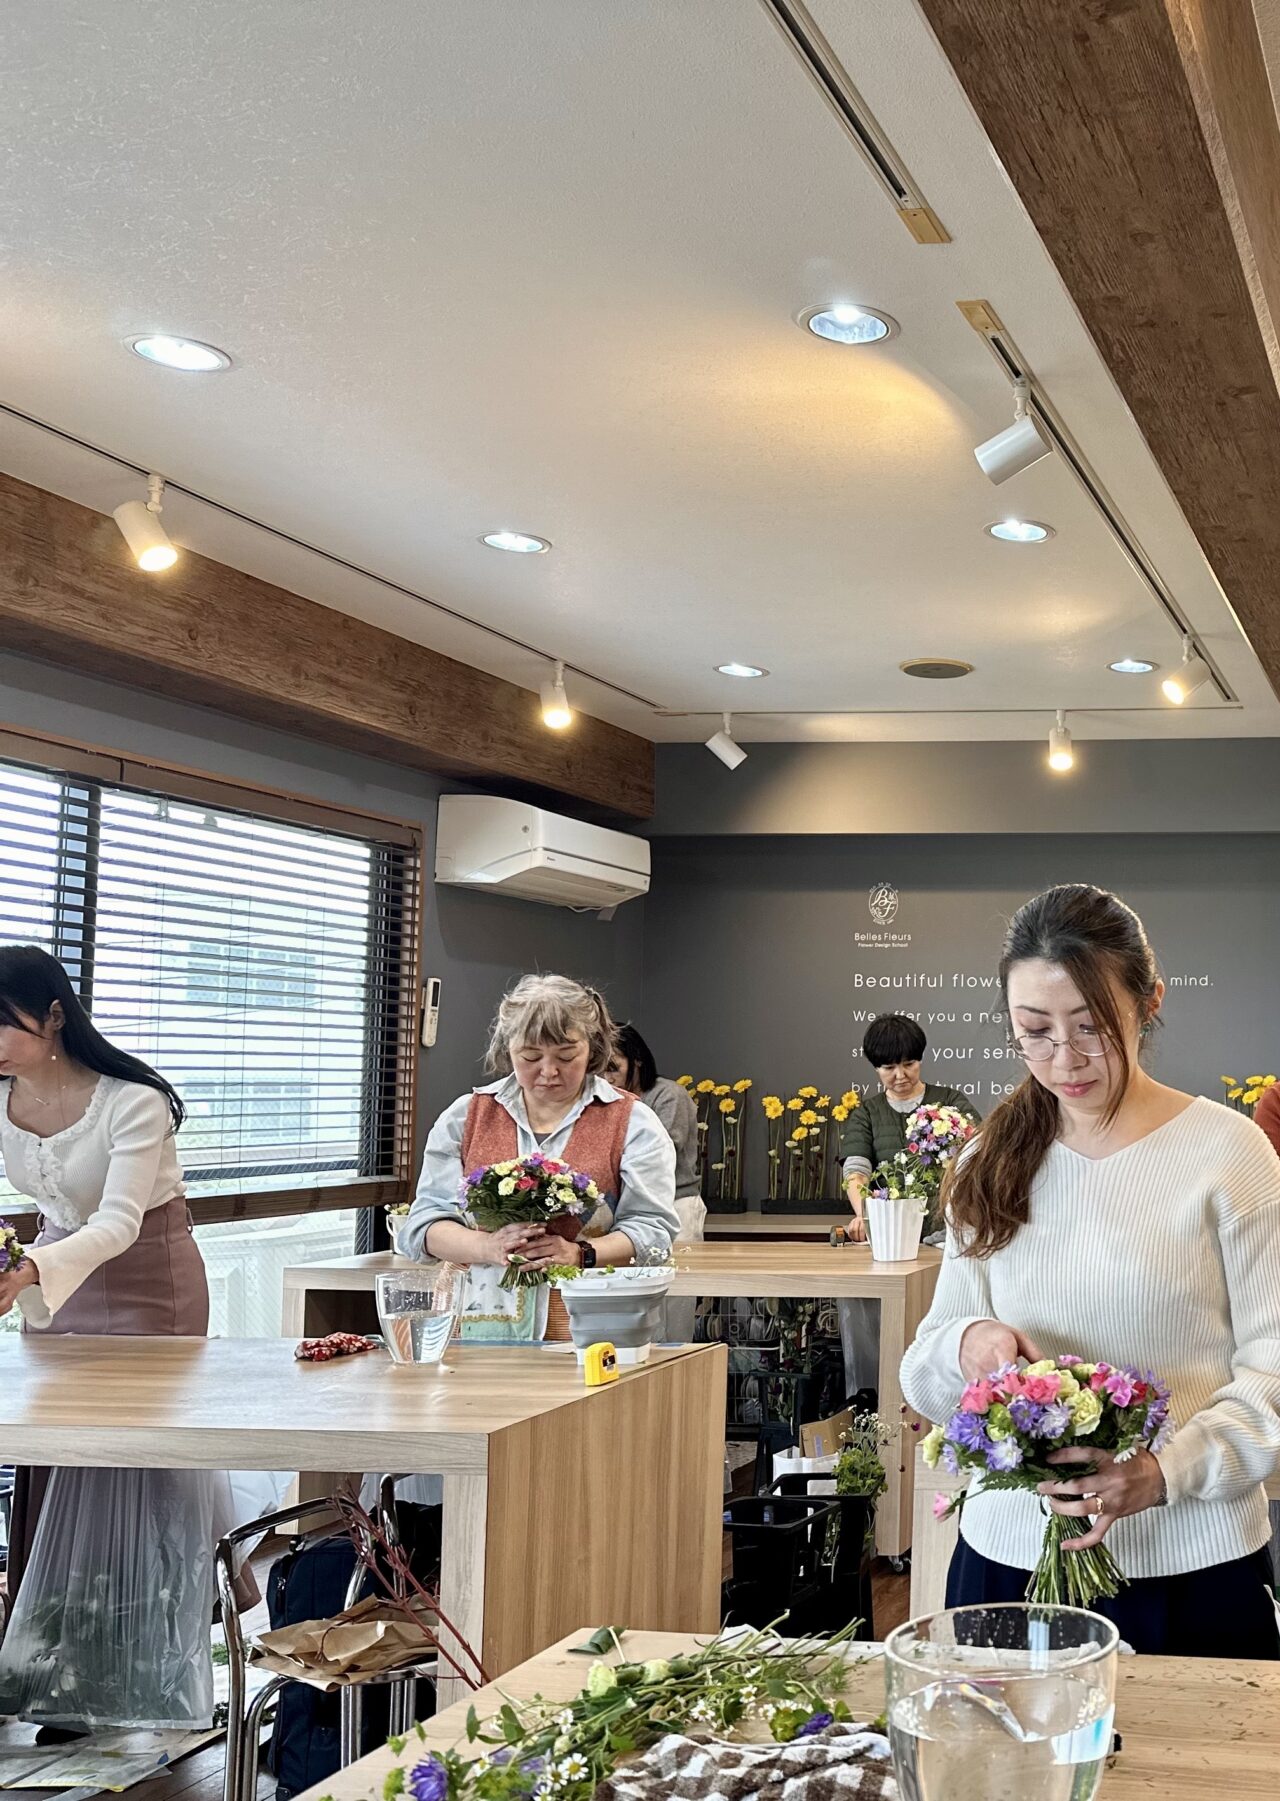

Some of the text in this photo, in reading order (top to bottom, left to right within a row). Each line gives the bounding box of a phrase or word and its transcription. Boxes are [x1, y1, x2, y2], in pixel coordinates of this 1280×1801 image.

[854, 932, 912, 941] Belles Fleurs
[853, 973, 943, 988] Beautiful
[1170, 974, 1214, 986] mind.
[853, 1010, 877, 1022] We
[927, 1012, 956, 1024] you
[962, 1012, 972, 1022] a
[932, 1047, 974, 1062] your
[851, 1081, 870, 1096] by
